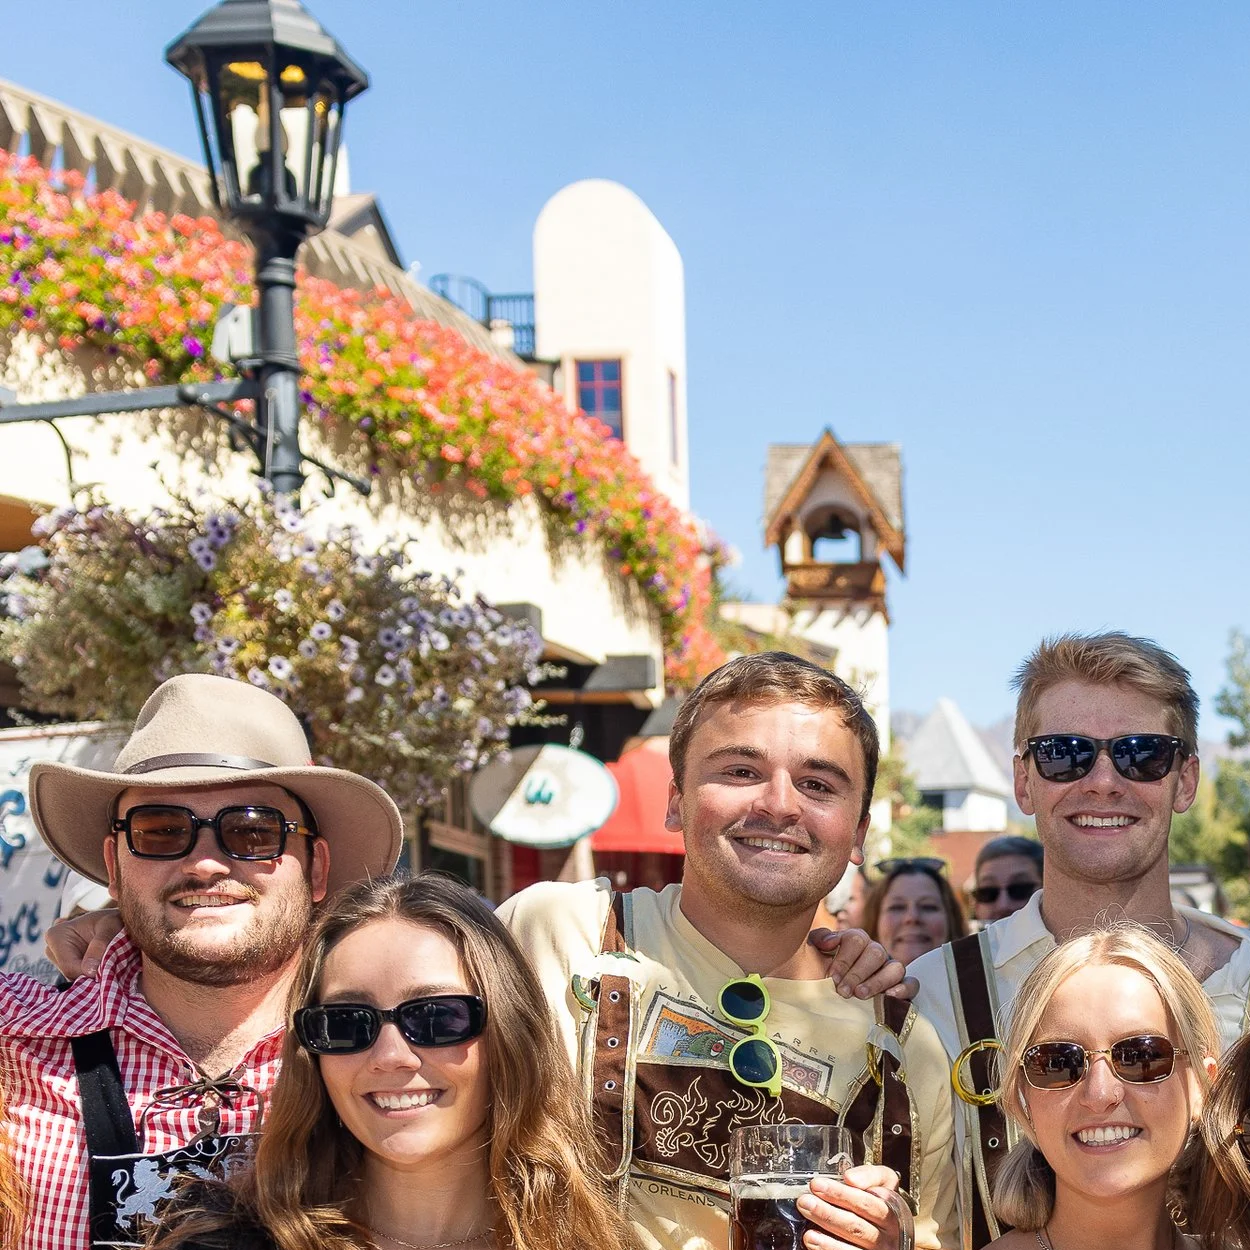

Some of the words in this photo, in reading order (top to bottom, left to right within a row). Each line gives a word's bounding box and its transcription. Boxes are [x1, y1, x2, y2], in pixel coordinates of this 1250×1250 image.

[658, 984, 715, 1015] VIEU
[773, 1032, 836, 1063] ARRE
[648, 1183, 716, 1207] ORLEANS
